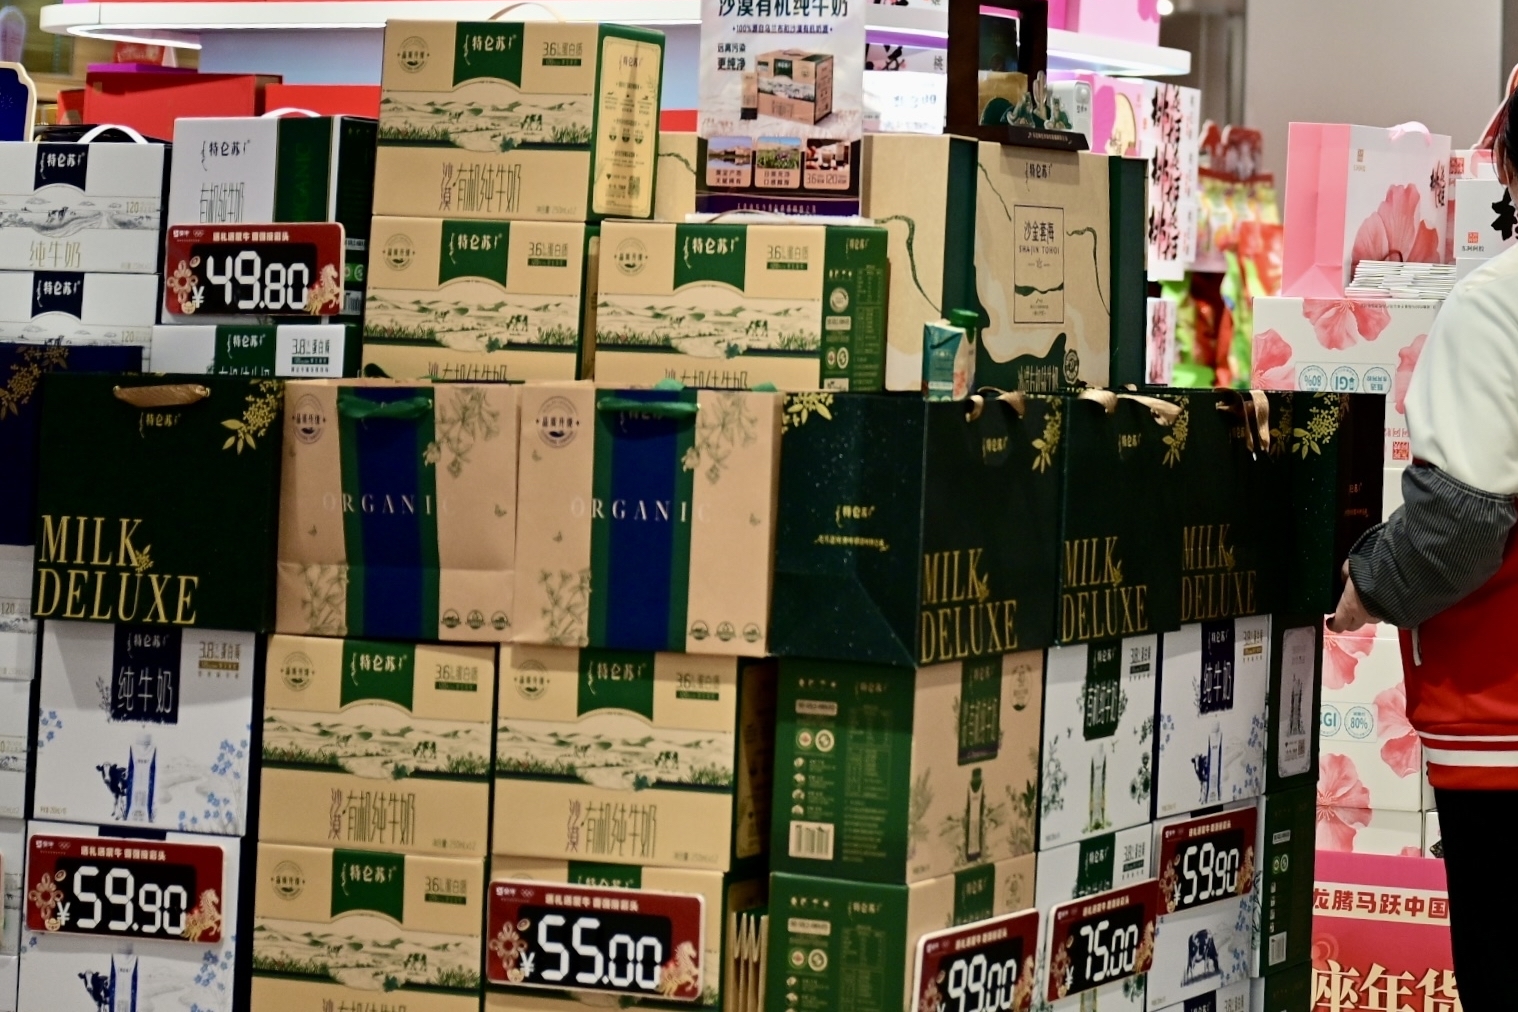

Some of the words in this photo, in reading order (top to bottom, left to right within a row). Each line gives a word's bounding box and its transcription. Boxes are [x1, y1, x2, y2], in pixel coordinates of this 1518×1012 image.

[206, 250, 309, 309] 49.80
[41, 515, 142, 567] MILK
[1064, 537, 1118, 588] MILK
[1183, 524, 1230, 570] MILK
[34, 567, 199, 625] DELUXE
[923, 548, 984, 606] MILK
[1181, 571, 1257, 621] DELUXE
[921, 600, 1018, 663] DELUXE
[1062, 585, 1148, 642] DELUXE
[118, 666, 173, 713] 纯牛奶
[73, 866, 187, 935] 59.90
[1183, 843, 1239, 904] 59.90
[1314, 888, 1448, 919] 龙腾马跃中国
[538, 914, 662, 989] 55.00
[1081, 921, 1139, 982] 75.00
[949, 954, 1017, 1012] 99.00
